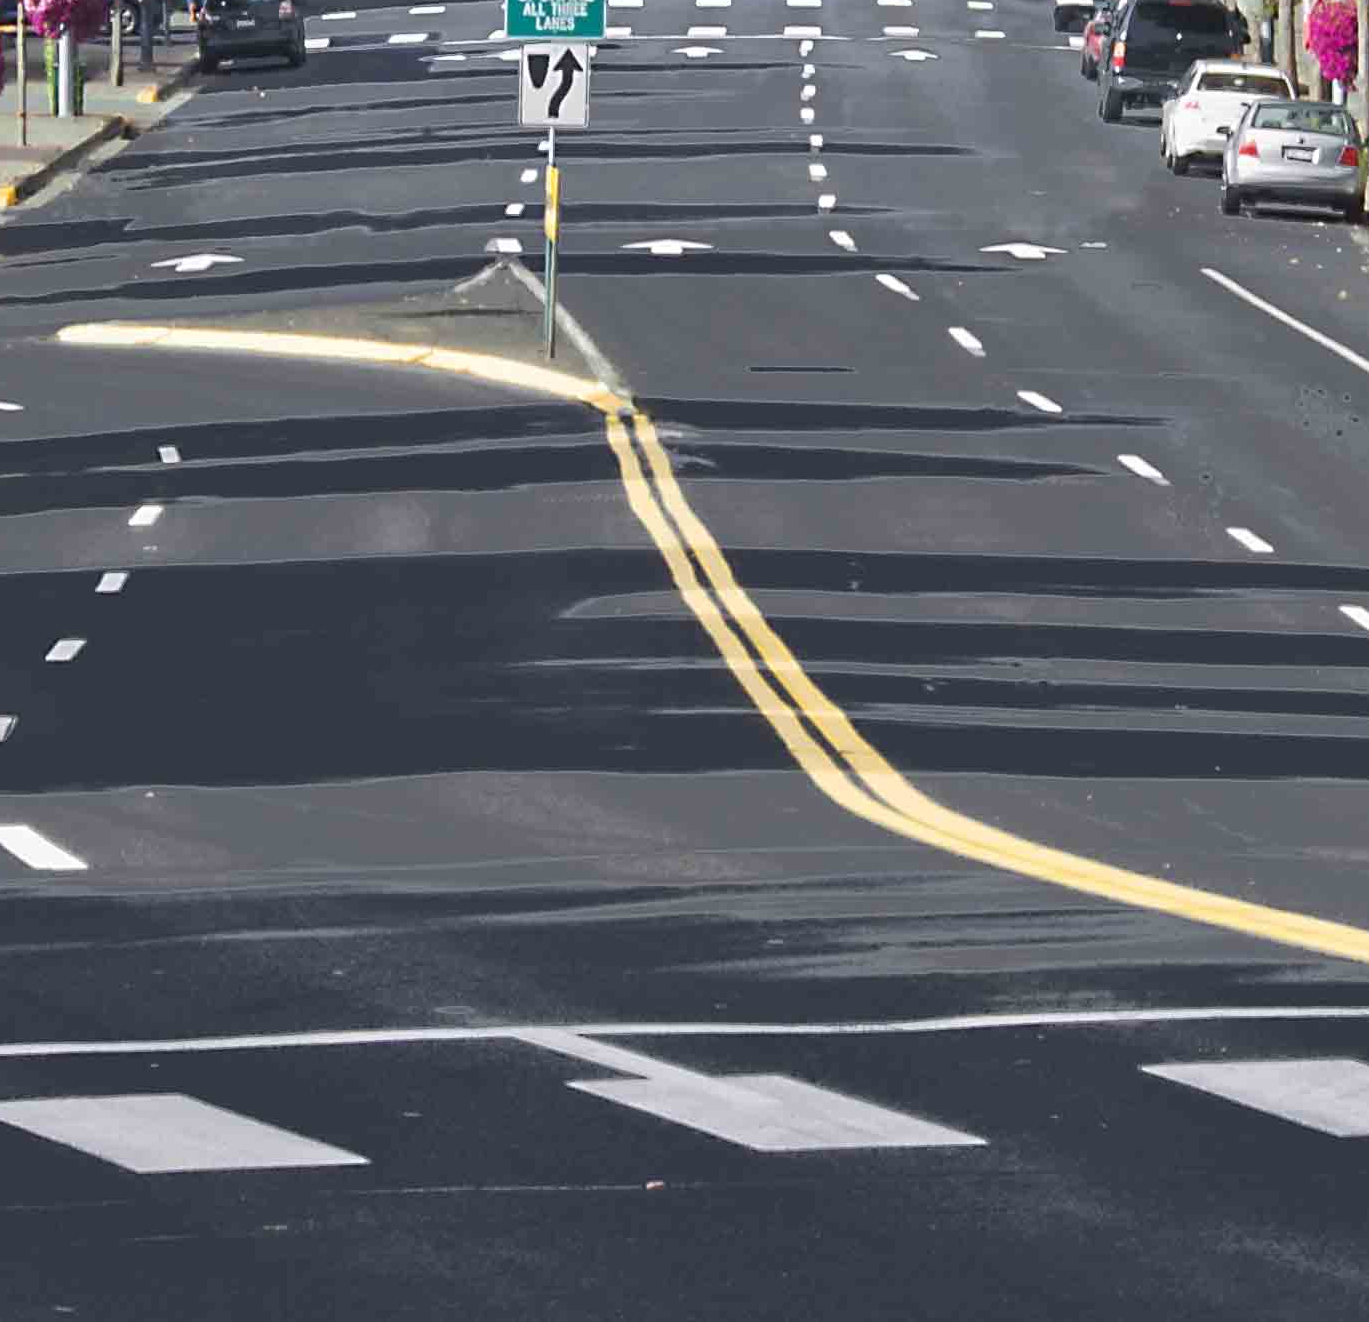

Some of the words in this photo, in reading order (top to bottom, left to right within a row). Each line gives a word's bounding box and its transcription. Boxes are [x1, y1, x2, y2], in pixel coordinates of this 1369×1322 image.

[523, 2, 545, 16] ALL
[552, 2, 588, 16] THREE
[535, 16, 575, 30] LANES
